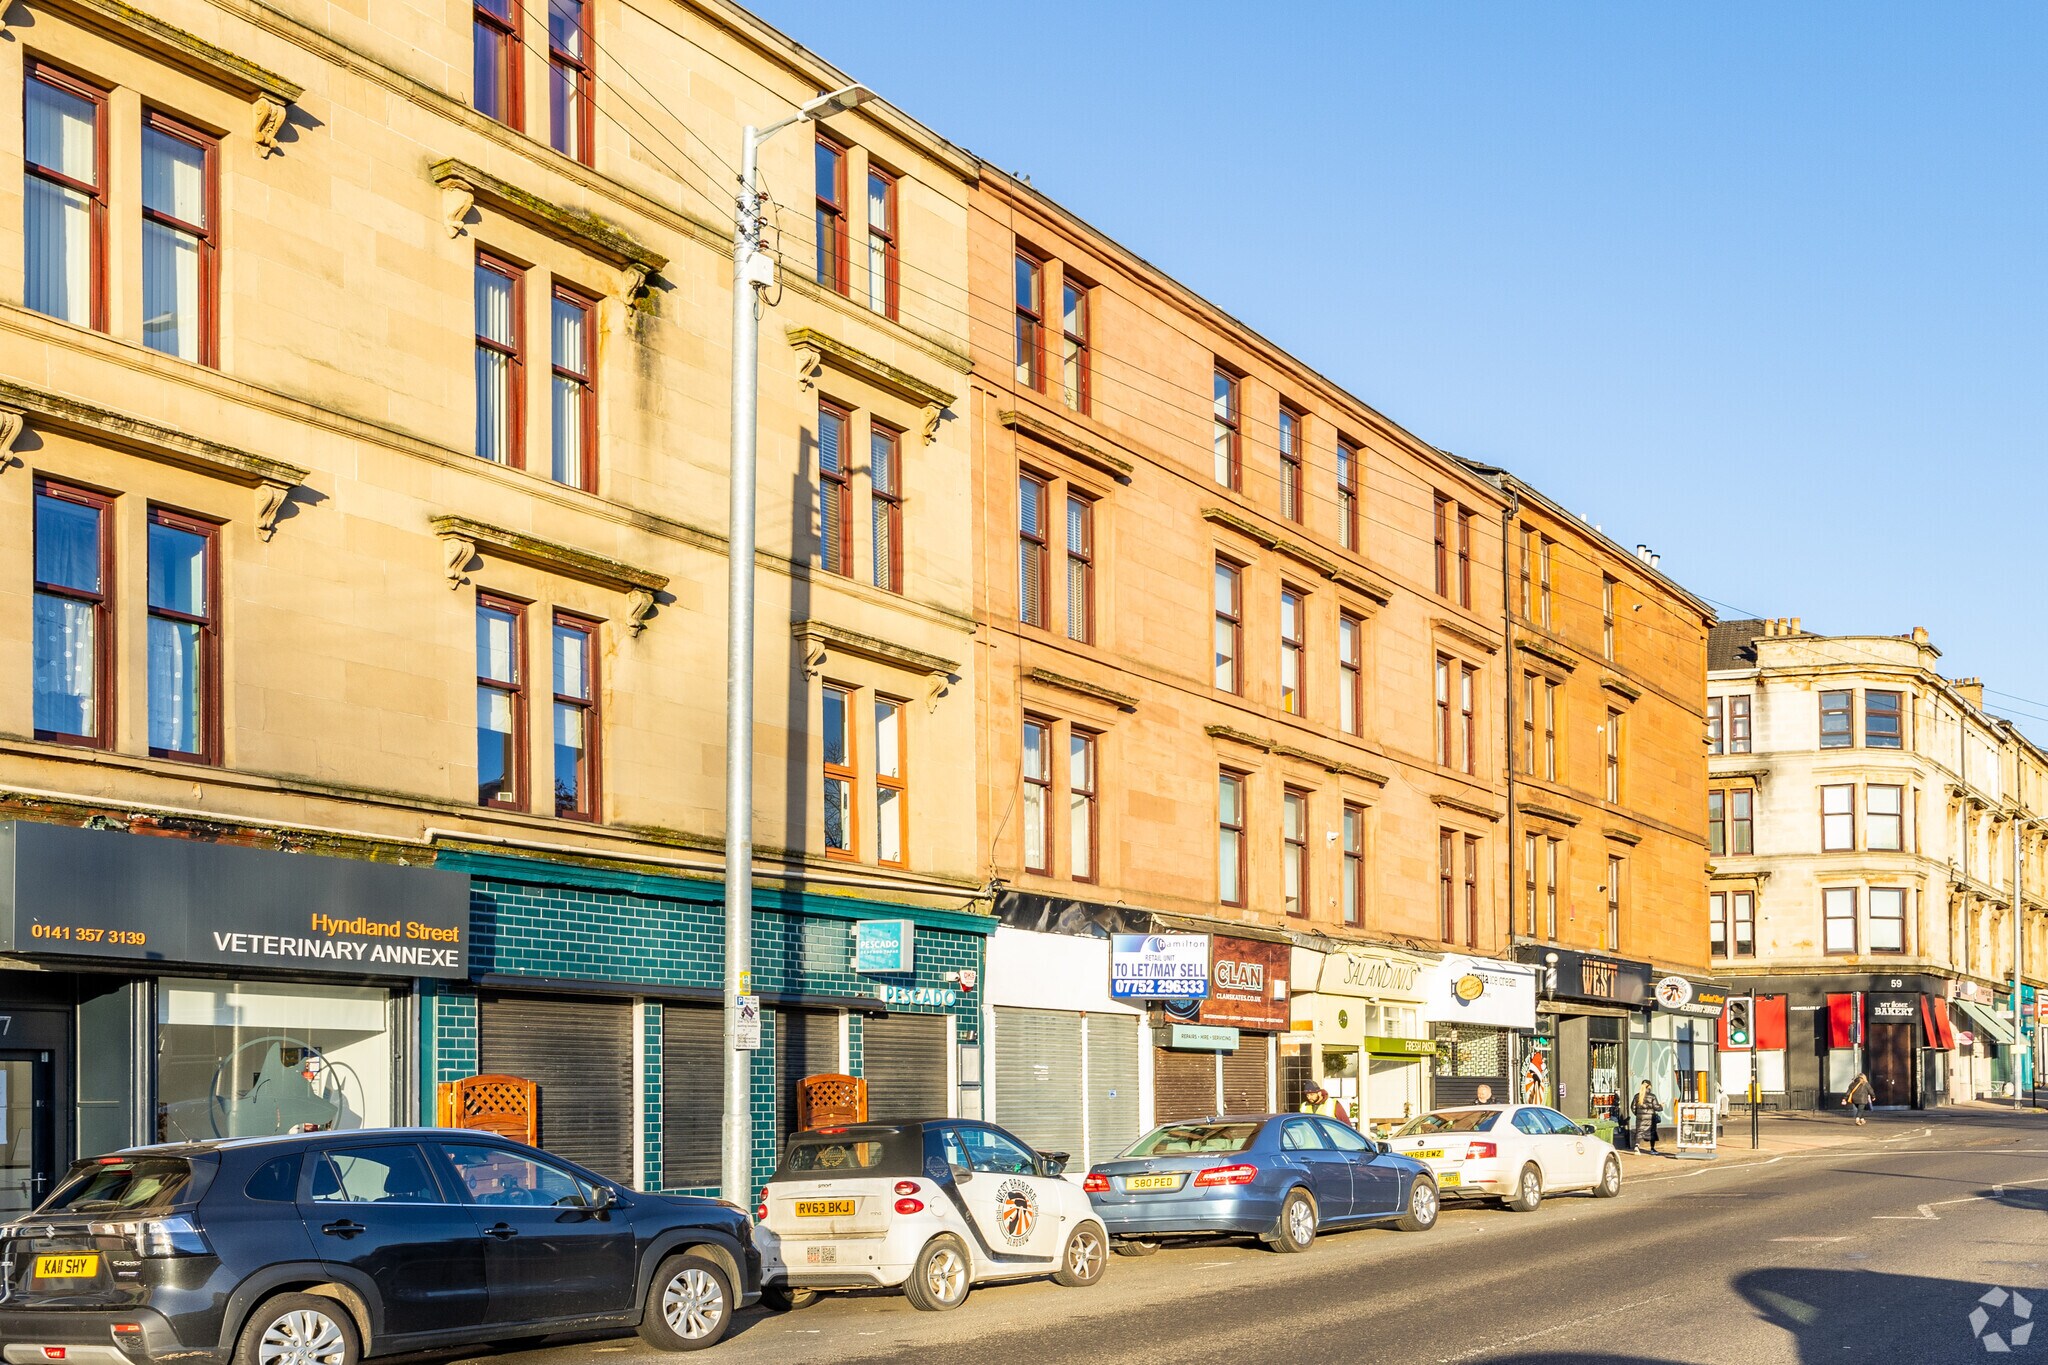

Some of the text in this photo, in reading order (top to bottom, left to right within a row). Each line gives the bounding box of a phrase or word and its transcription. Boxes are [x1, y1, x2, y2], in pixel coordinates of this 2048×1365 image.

[311, 913, 460, 942] Hyndland Street
[31, 924, 147, 946] 0141 357 3139
[213, 931, 459, 968] VETERINARY ANNEXE
[860, 940, 899, 949] PESCADO
[1159, 938, 1205, 951] hamilton
[1115, 963, 1206, 977] TO LET/MAY SELL
[1214, 959, 1264, 992] CLAN
[1344, 962, 1417, 991] SALANDINI'S
[1499, 977, 1516, 987] cream
[1582, 959, 1618, 998] WEST
[1890, 979, 1903, 988] 59
[1115, 980, 1205, 993] 07752 296333
[885, 985, 957, 1007] PESCADO
[1216, 992, 1261, 1003] CLANSKATES.CO.UK
[1874, 1007, 1914, 1016] BAKERY
[1405, 1041, 1436, 1053] FRESH PASTA
[1134, 1177, 1173, 1188] S80 PED
[995, 1181, 1009, 1204] WEST
[799, 1201, 850, 1214] RV63 BKJ
[66, 1259, 88, 1273] SHY
